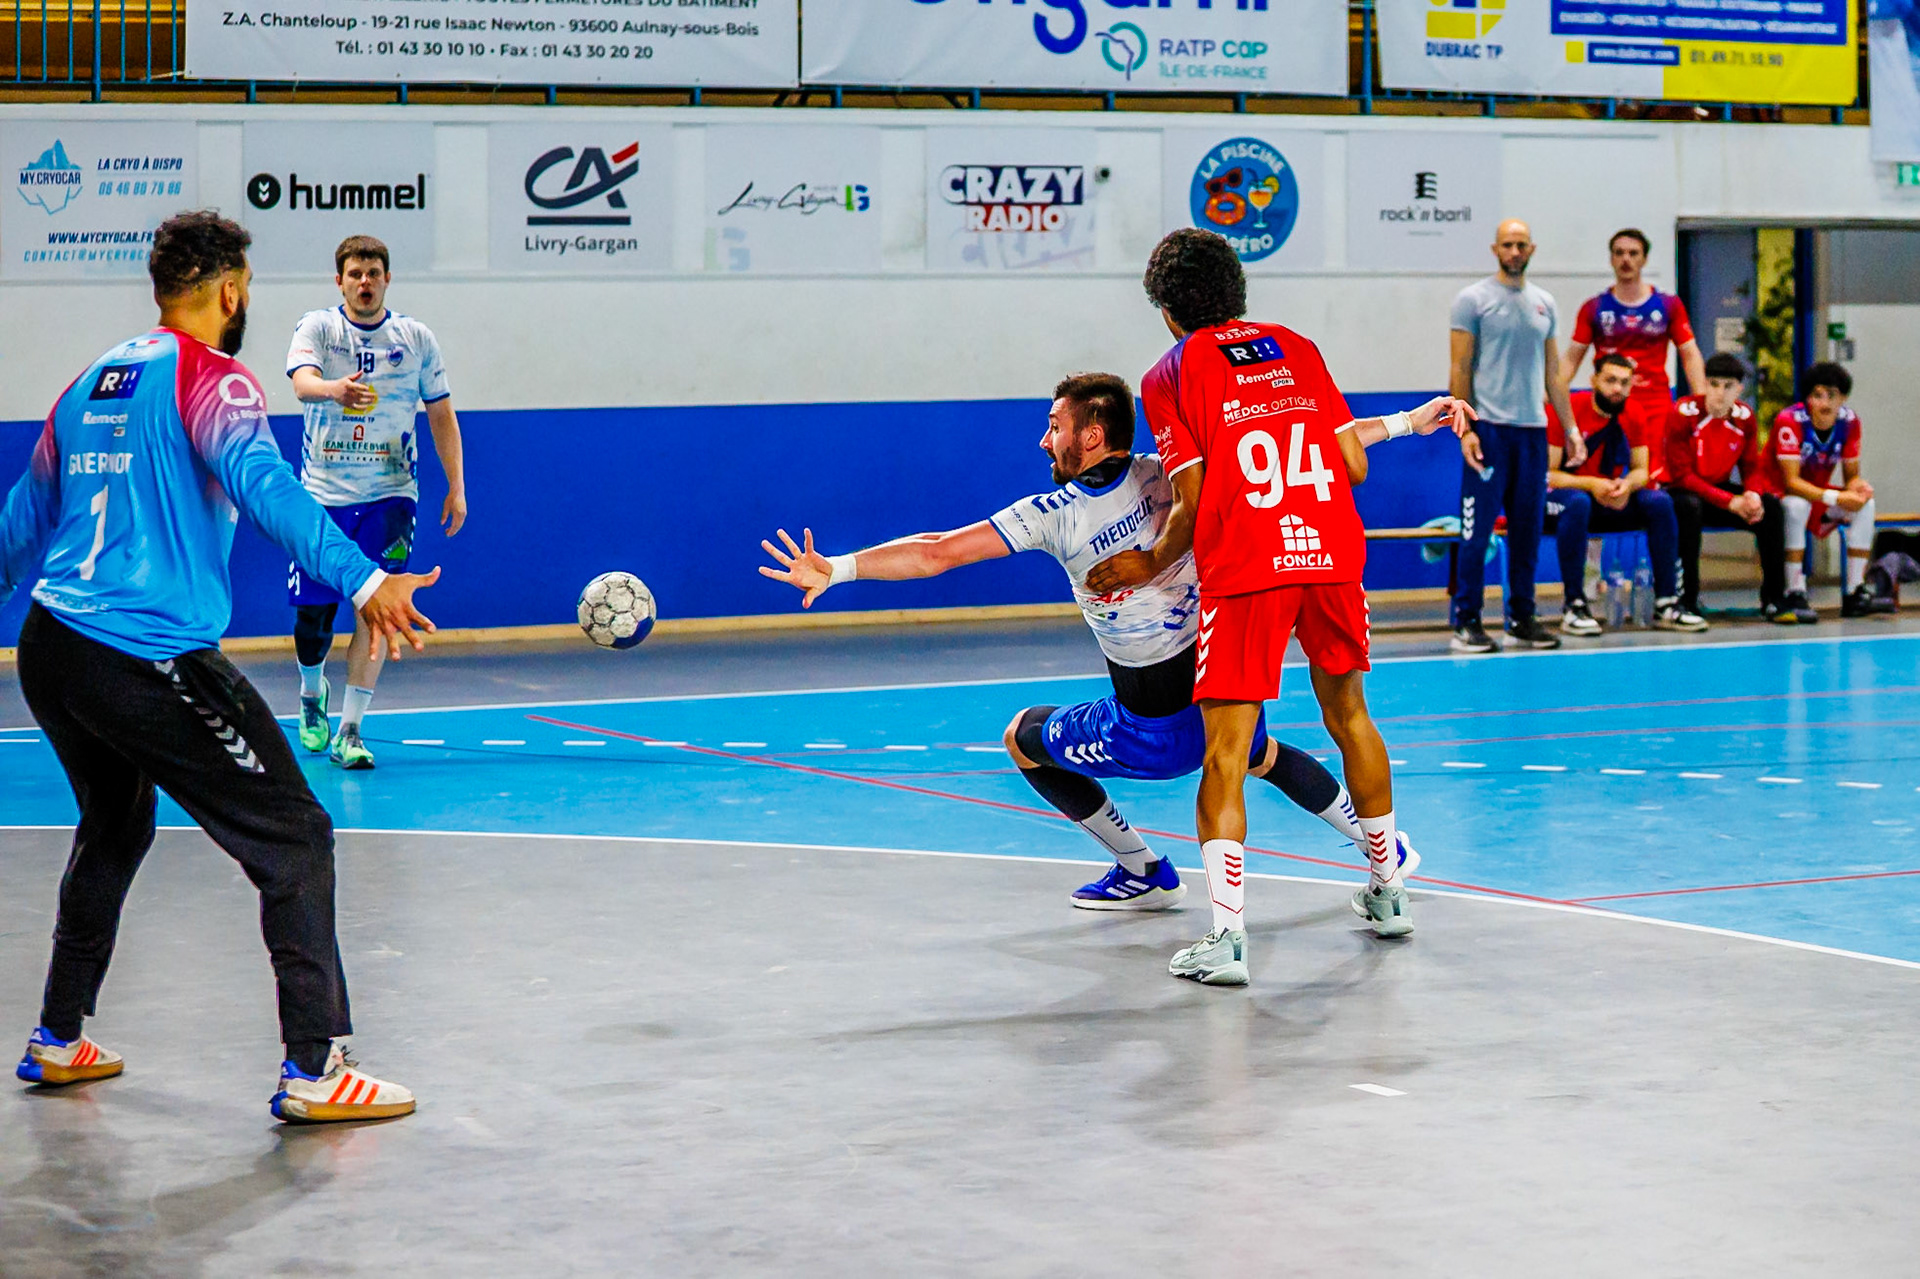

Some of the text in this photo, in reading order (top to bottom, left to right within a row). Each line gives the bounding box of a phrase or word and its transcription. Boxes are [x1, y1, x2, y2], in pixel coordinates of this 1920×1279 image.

[222, 12, 256, 26] Z.A.
[260, 13, 358, 31] Chanteloup
[371, 15, 409, 29] 19-21
[414, 18, 441, 29] rue
[445, 16, 487, 30] Isaac
[491, 18, 556, 32] Newton
[568, 19, 618, 34] 93600
[622, 20, 760, 37] Aulnay-sous-Bois
[376, 41, 394, 55] 01
[398, 42, 418, 56] 43
[423, 42, 443, 56] 30
[447, 43, 465, 56] 10
[469, 43, 485, 56] 10
[499, 43, 528, 57] Fax
[541, 44, 558, 57] 01
[562, 44, 582, 58] 43
[586, 45, 605, 58] 30
[609, 45, 630, 59] 20
[633, 45, 653, 59] 20
[1159, 39, 1216, 57] RATP
[1425, 41, 1504, 59] DUBRAC TP
[97, 158, 110, 171] LA
[113, 158, 140, 171] CRYO
[152, 158, 183, 171] DISPO
[1200, 142, 1285, 181] LA PISCINE
[289, 172, 426, 210] hummel
[940, 165, 1084, 205] CRAZY
[967, 205, 1067, 232] RADIO
[525, 235, 638, 254] Livry-Gargan
[1236, 366, 1292, 386] Rematch
[1224, 395, 1317, 423] MEDOC OPTIQUE
[1236, 422, 1335, 509] 94
[1273, 552, 1334, 570] FONCIA
